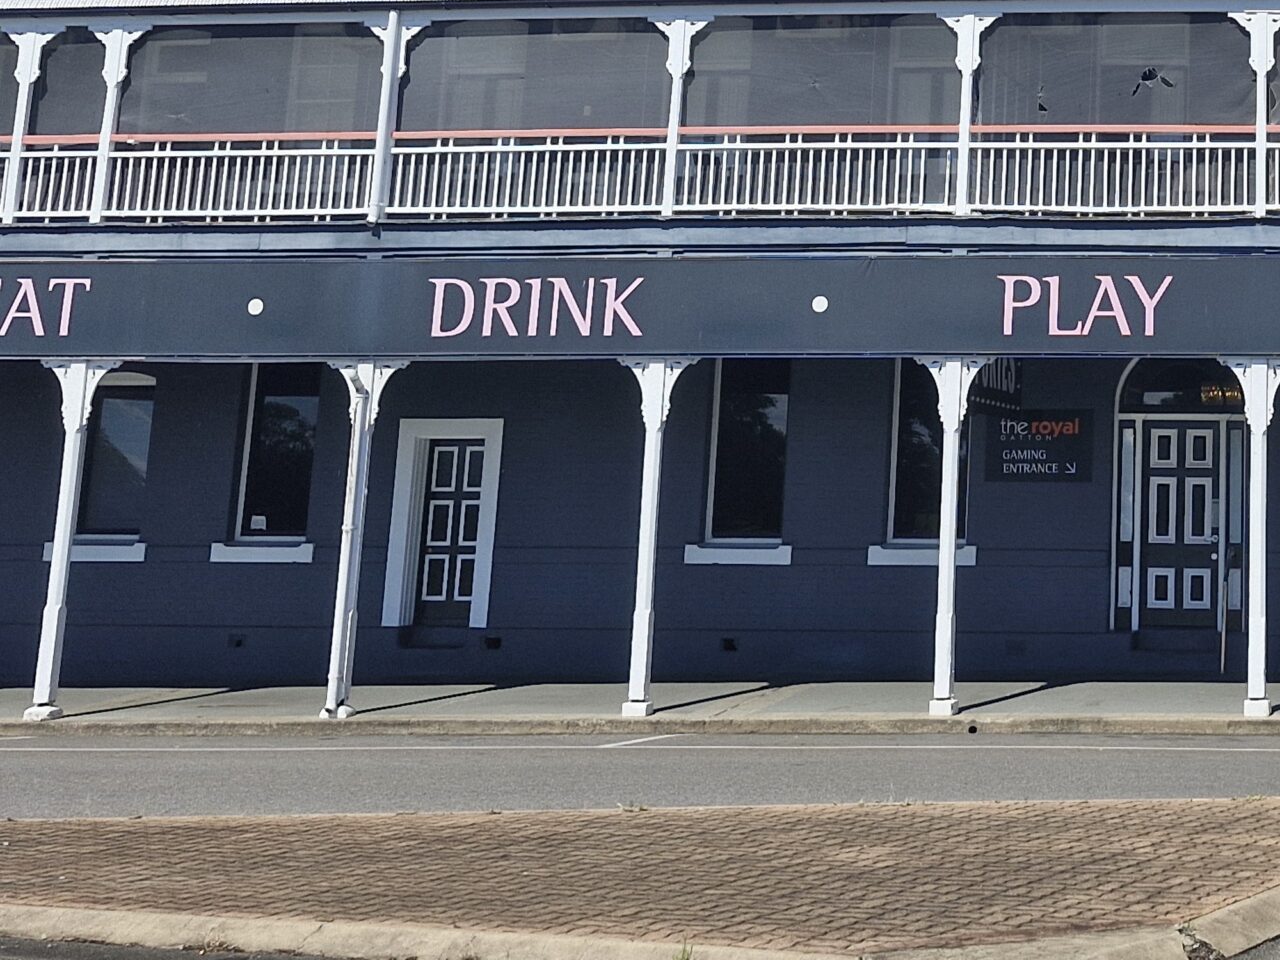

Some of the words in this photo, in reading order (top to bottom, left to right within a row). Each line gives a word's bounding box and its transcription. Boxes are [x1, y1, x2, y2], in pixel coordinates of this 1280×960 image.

[0, 277, 92, 337] AT
[427, 277, 645, 337] DRINK
[996, 275, 1174, 337] PLAY
[1002, 450, 1047, 460] GAMING
[1003, 463, 1059, 474] ENTRANCE
